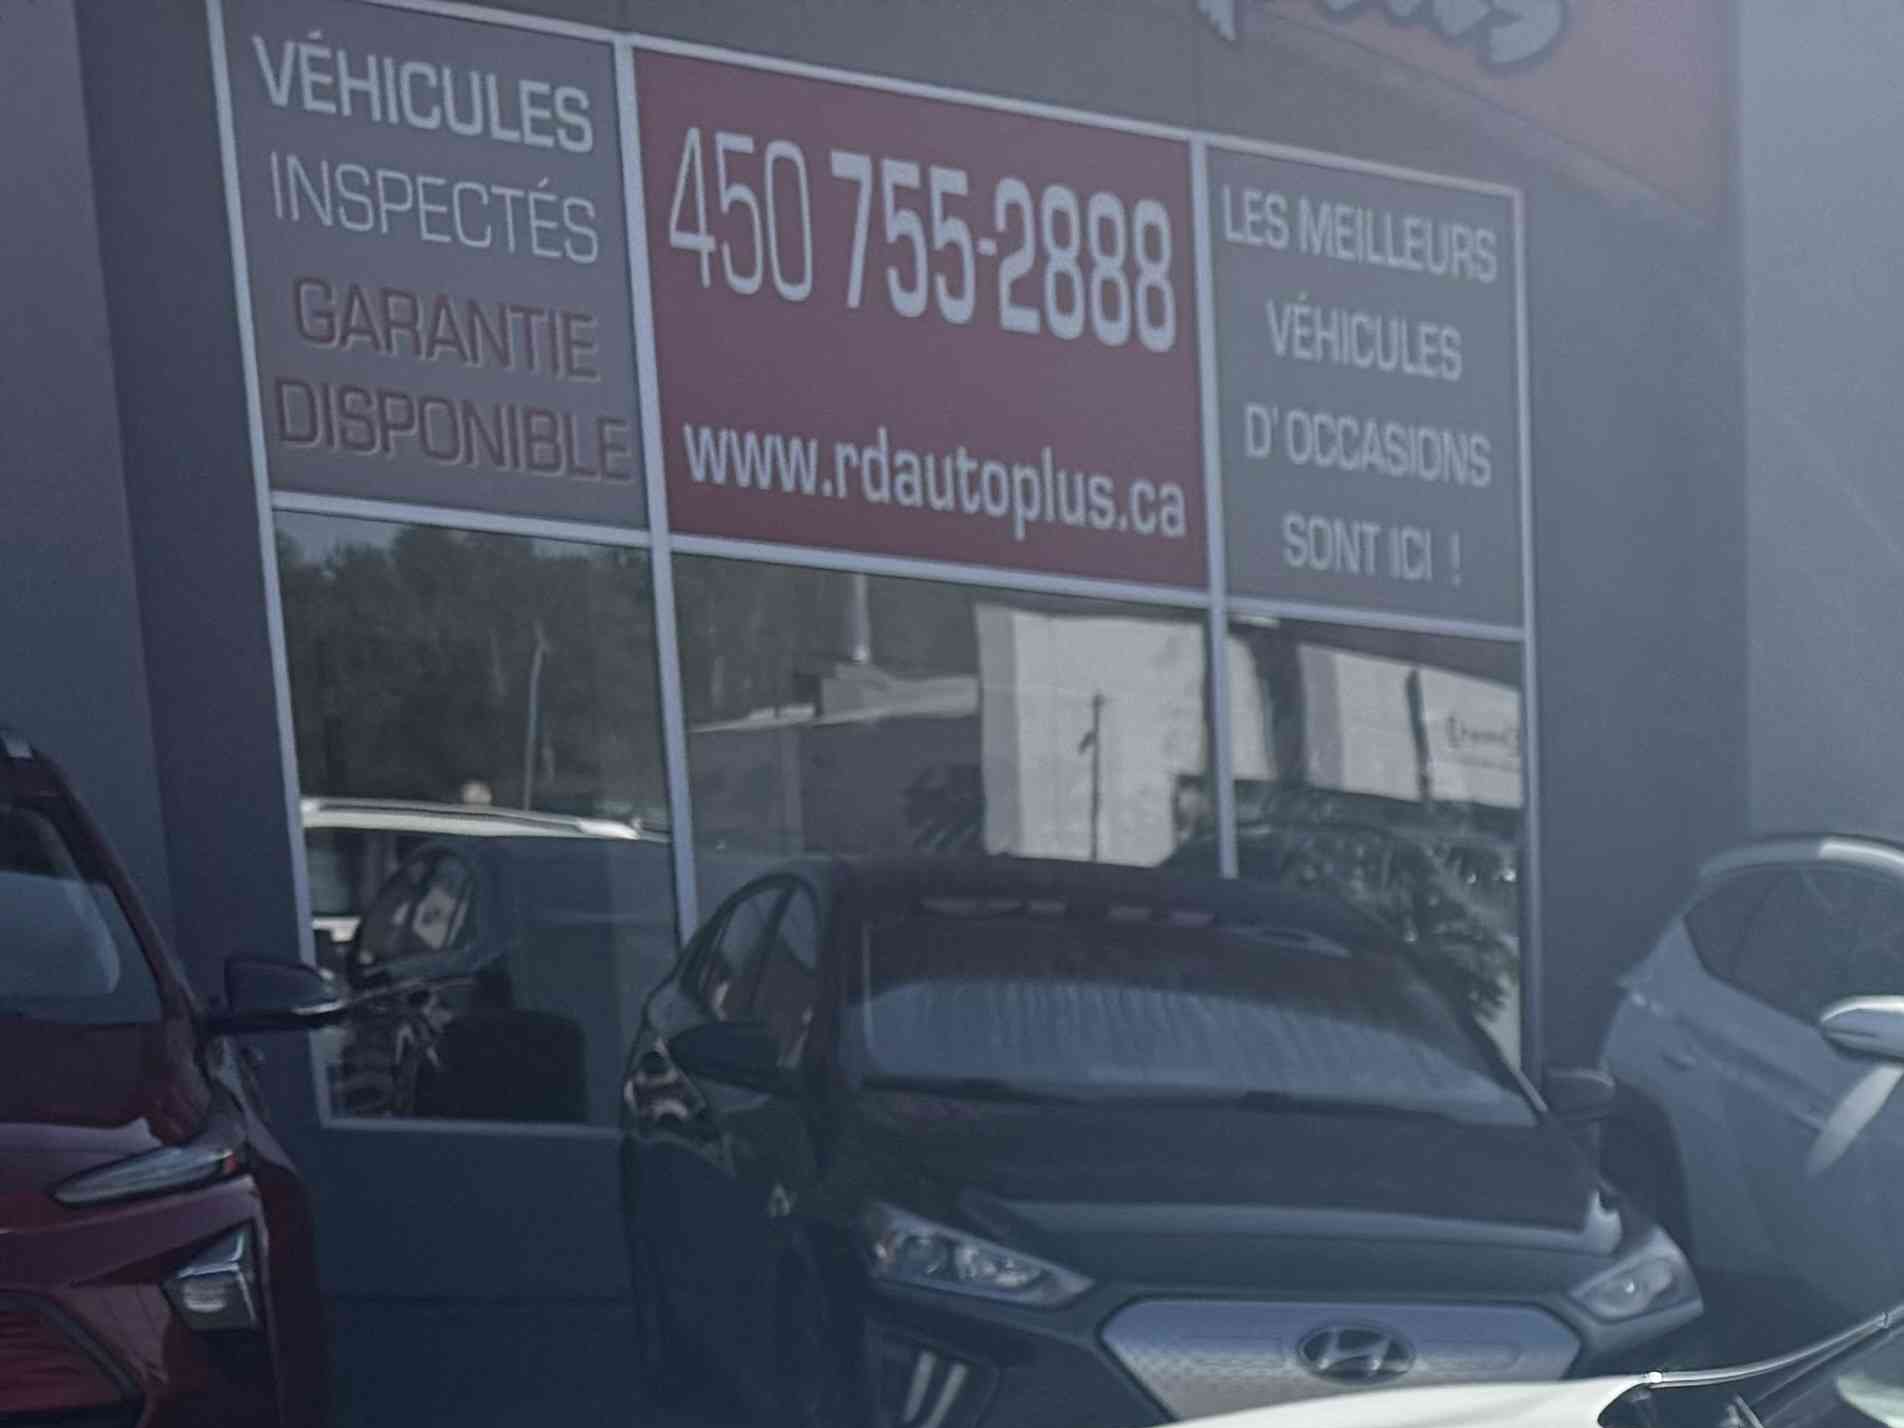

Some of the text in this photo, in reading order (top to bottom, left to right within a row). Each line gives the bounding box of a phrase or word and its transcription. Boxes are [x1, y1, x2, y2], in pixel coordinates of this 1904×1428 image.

[253, 30, 593, 152] VÉHICULES
[270, 151, 599, 264] INSPECTÉS
[669, 127, 1176, 352] 450 755-2888
[1222, 184, 1497, 284] LES MEILLEURS
[292, 276, 601, 382] GARANTIE
[1267, 292, 1463, 383] VÉHICULES
[277, 378, 636, 483] DISPONIBLE
[684, 422, 1186, 540] www.rdautoplus.ca
[1283, 513, 1380, 572] SONT
[1389, 527, 1432, 581] ICI
